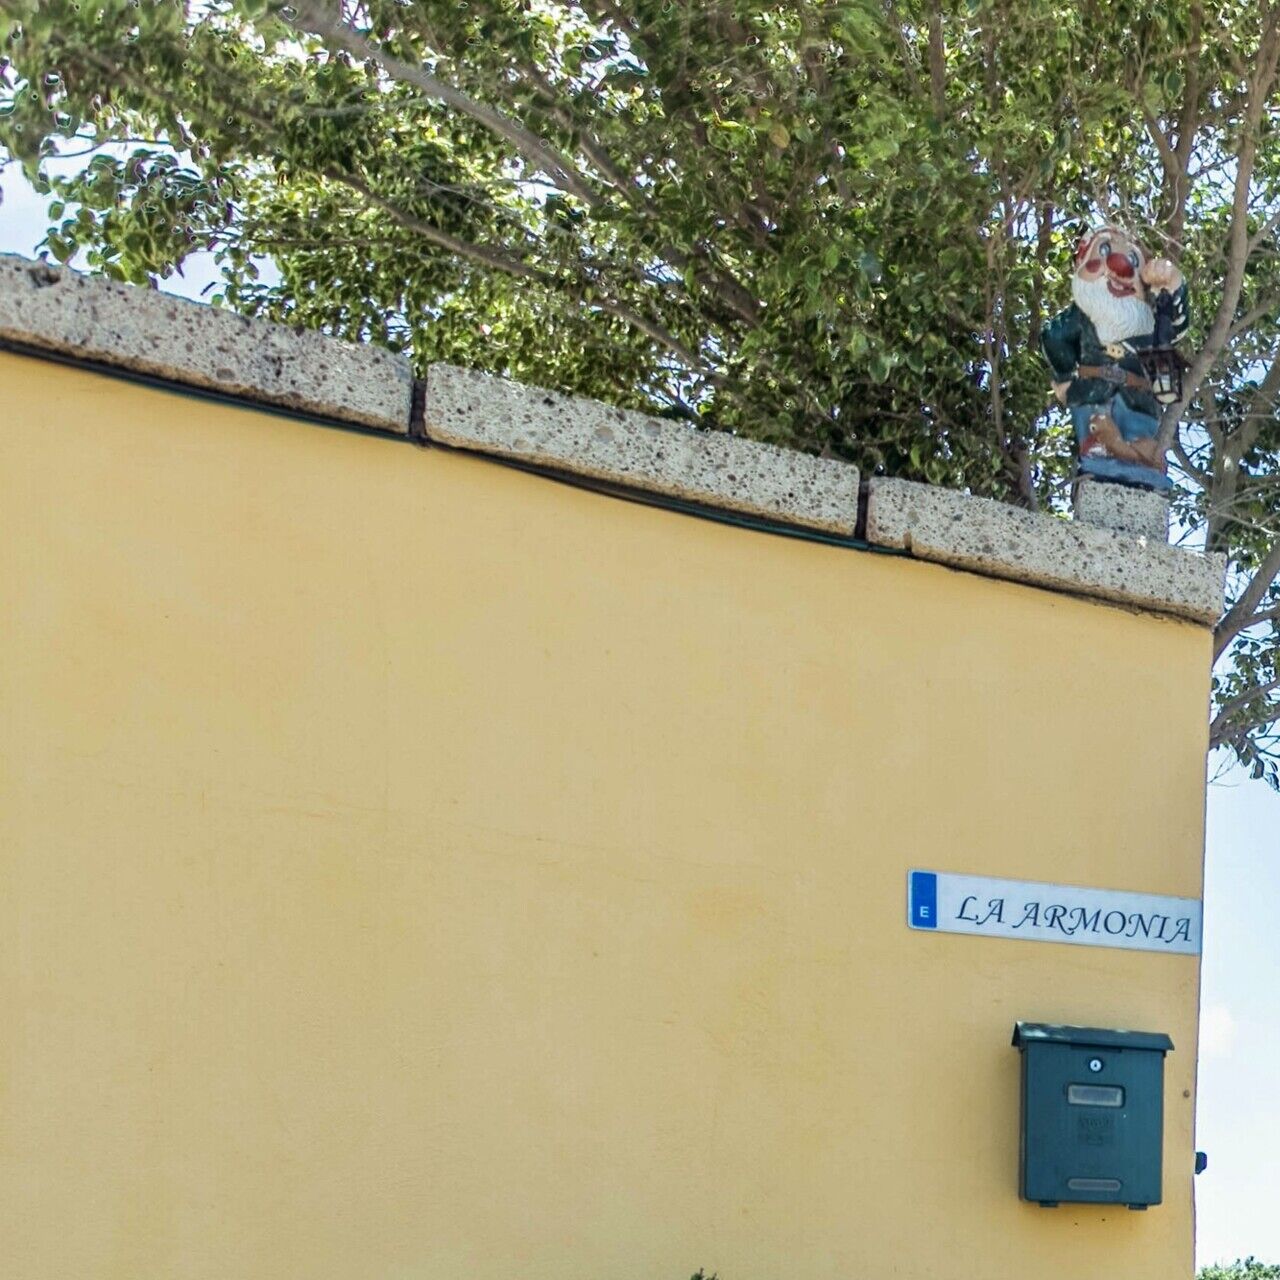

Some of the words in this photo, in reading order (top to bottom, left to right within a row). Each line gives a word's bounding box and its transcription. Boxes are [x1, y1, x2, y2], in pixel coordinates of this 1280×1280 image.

[919, 906, 930, 918] E
[955, 896, 1005, 925] LA
[1012, 902, 1193, 943] ARMONIA
